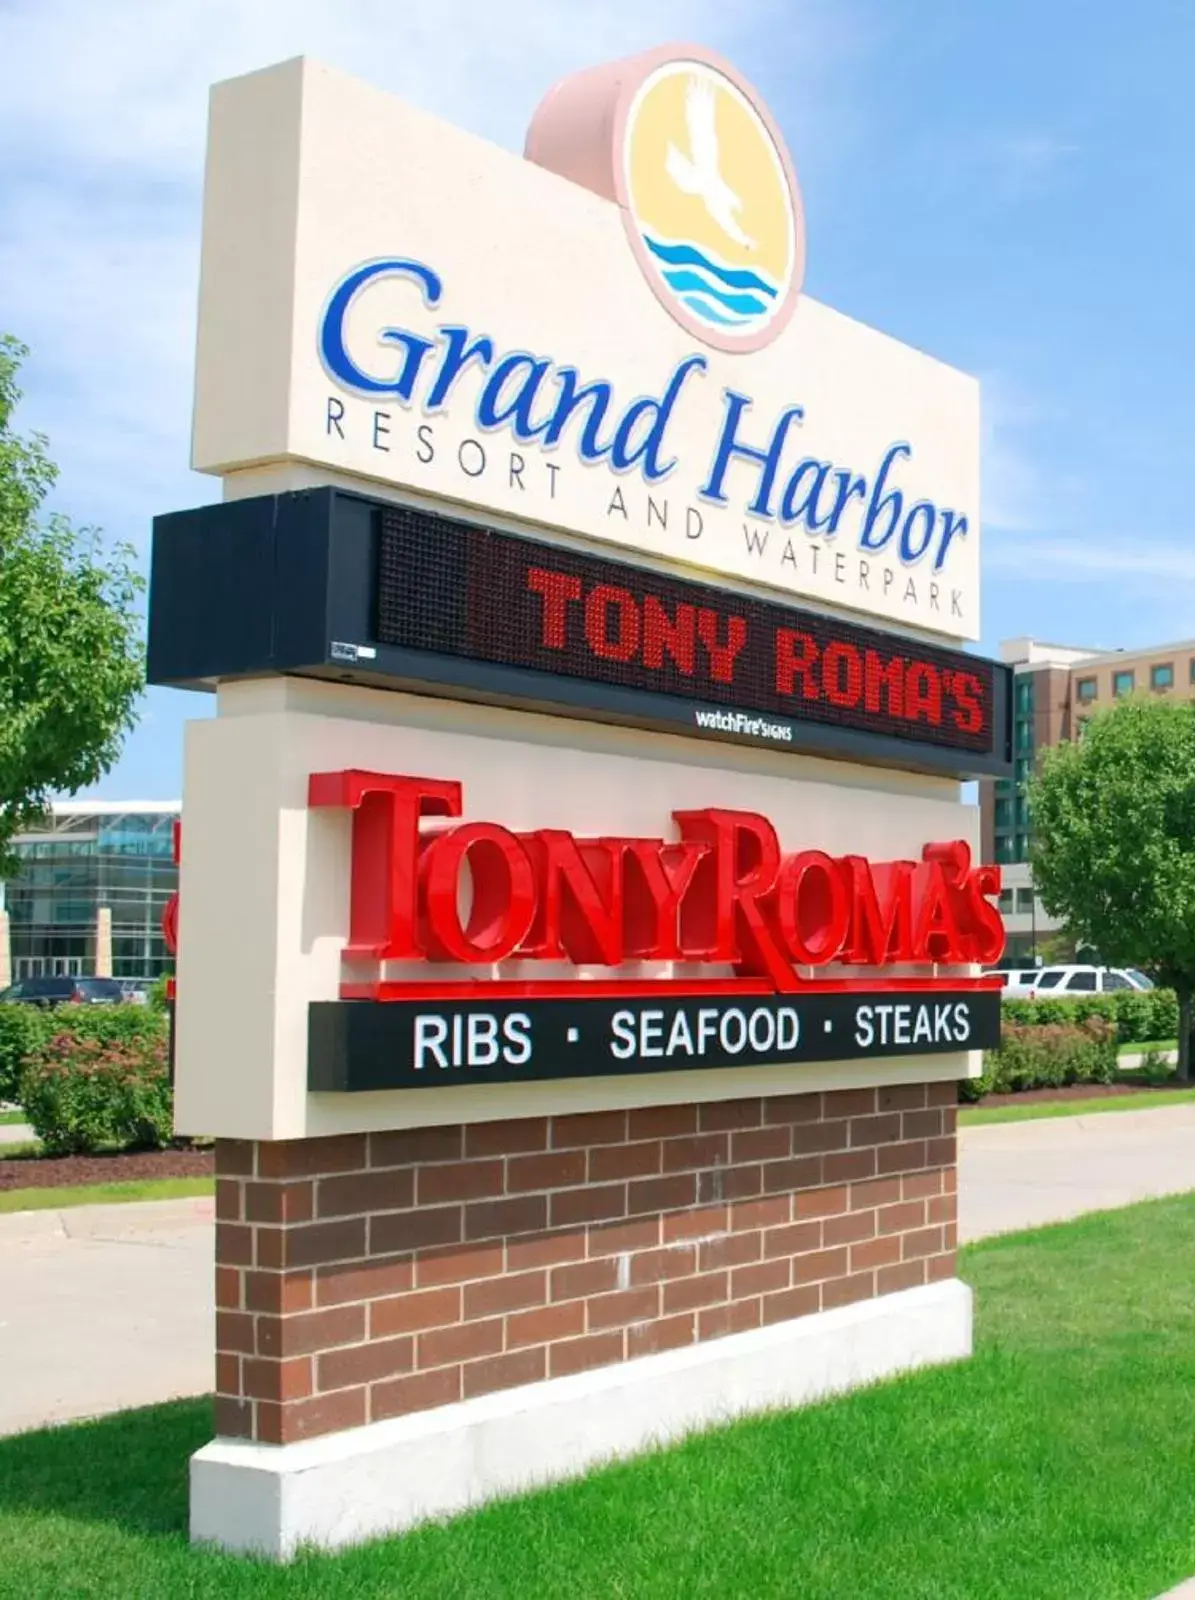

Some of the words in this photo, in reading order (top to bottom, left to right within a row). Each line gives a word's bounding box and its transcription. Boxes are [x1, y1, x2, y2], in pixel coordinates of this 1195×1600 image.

[316, 257, 711, 483] Grand
[696, 389, 970, 573] Harbor
[327, 396, 560, 500] RESORT
[606, 485, 704, 541] AND
[743, 524, 964, 618] WATERPARK
[527, 567, 747, 684] TONY
[775, 627, 984, 735] ROMA'S
[414, 1012, 533, 1069] RIBS
[610, 1007, 800, 1060] SEAFOOD
[855, 1003, 971, 1048] STEAKS
